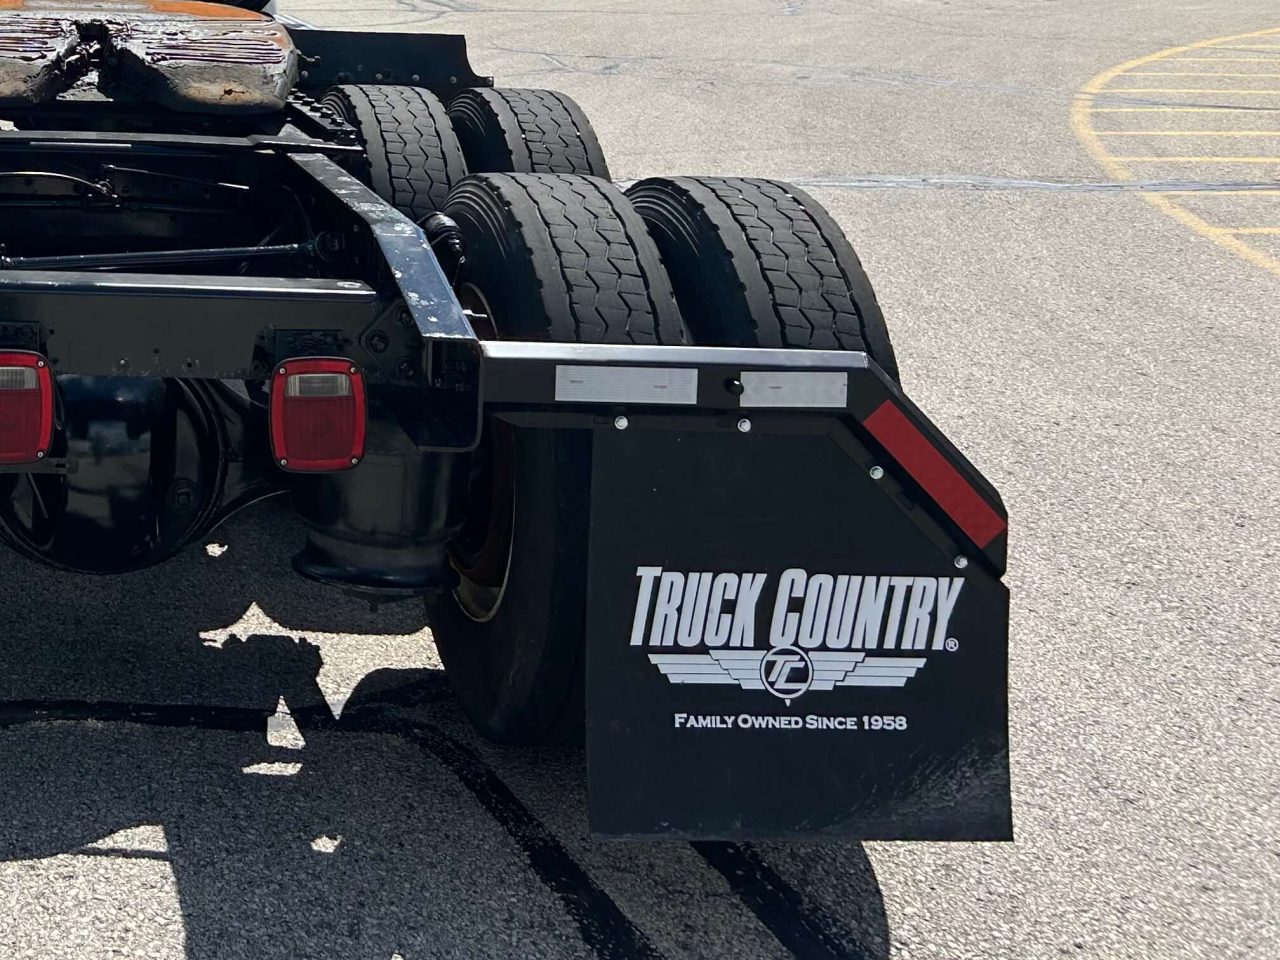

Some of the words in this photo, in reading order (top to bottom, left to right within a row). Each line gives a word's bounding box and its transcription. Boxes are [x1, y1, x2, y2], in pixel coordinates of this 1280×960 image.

[630, 566, 767, 647] TRUCK
[769, 568, 965, 651] COUNTRY
[674, 713, 735, 729] FAMILY
[738, 713, 803, 730] OWNED
[805, 714, 858, 731] SINCE
[862, 716, 908, 731] 1958
